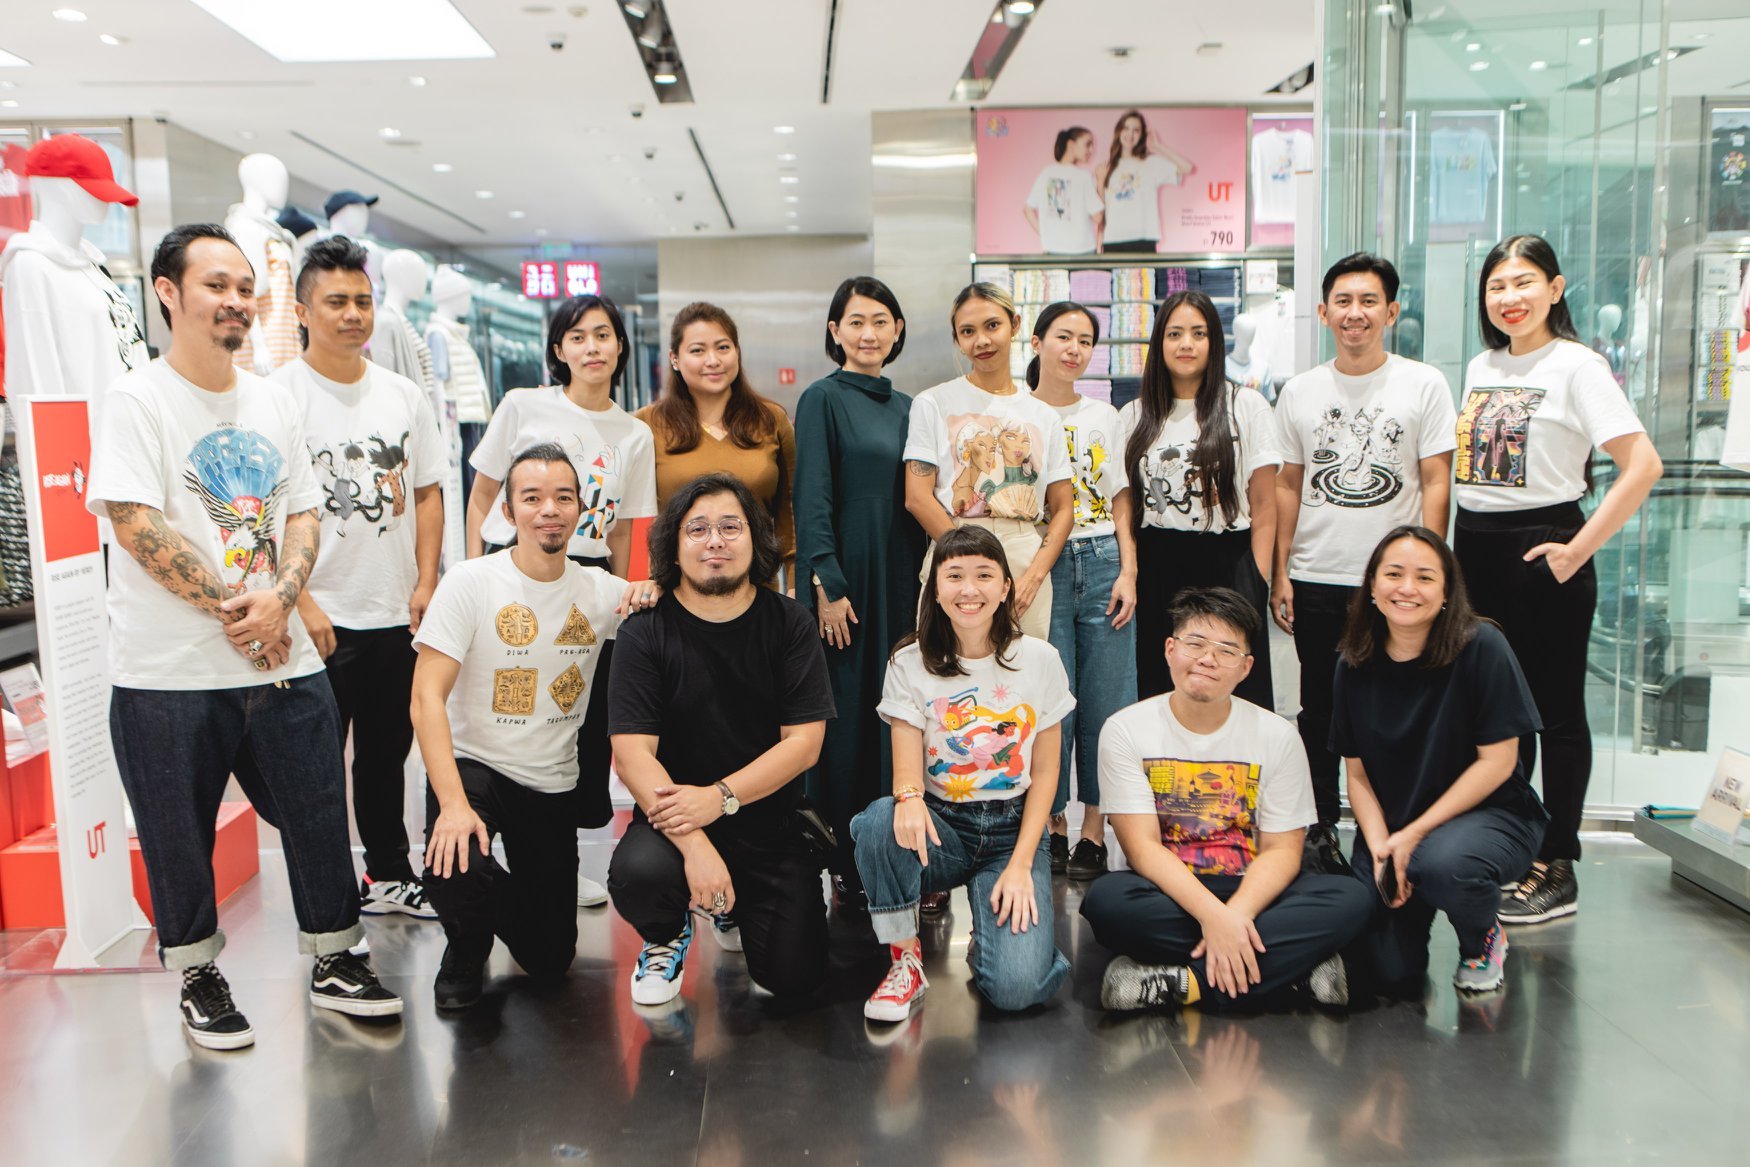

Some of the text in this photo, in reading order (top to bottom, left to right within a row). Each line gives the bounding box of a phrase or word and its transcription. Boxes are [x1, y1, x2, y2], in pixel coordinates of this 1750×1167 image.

[1209, 181, 1234, 202] UT
[496, 716, 527, 725] KAPWA
[87, 820, 106, 859] UT
